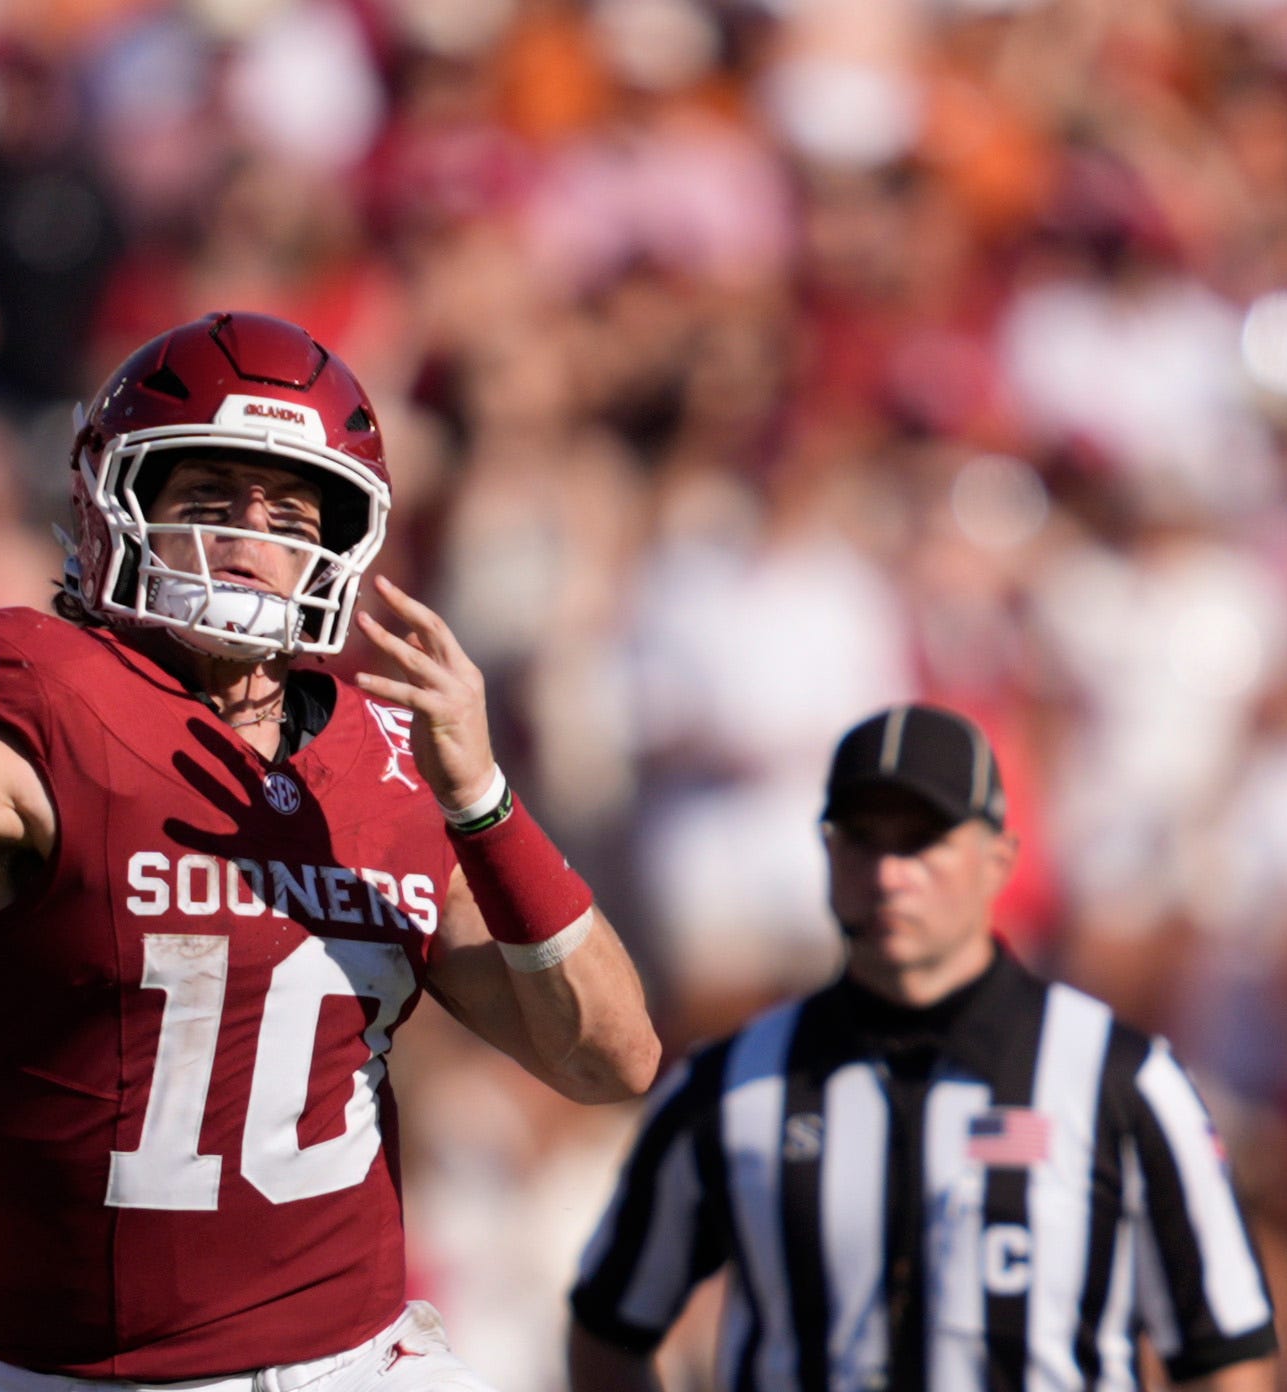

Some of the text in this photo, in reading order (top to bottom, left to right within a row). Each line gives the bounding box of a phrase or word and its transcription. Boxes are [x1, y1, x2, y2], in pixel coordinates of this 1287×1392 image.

[265, 774, 297, 811] SEC
[126, 851, 438, 935] SOONERS
[104, 933, 417, 1211] 10
[986, 1225, 1030, 1294] C
